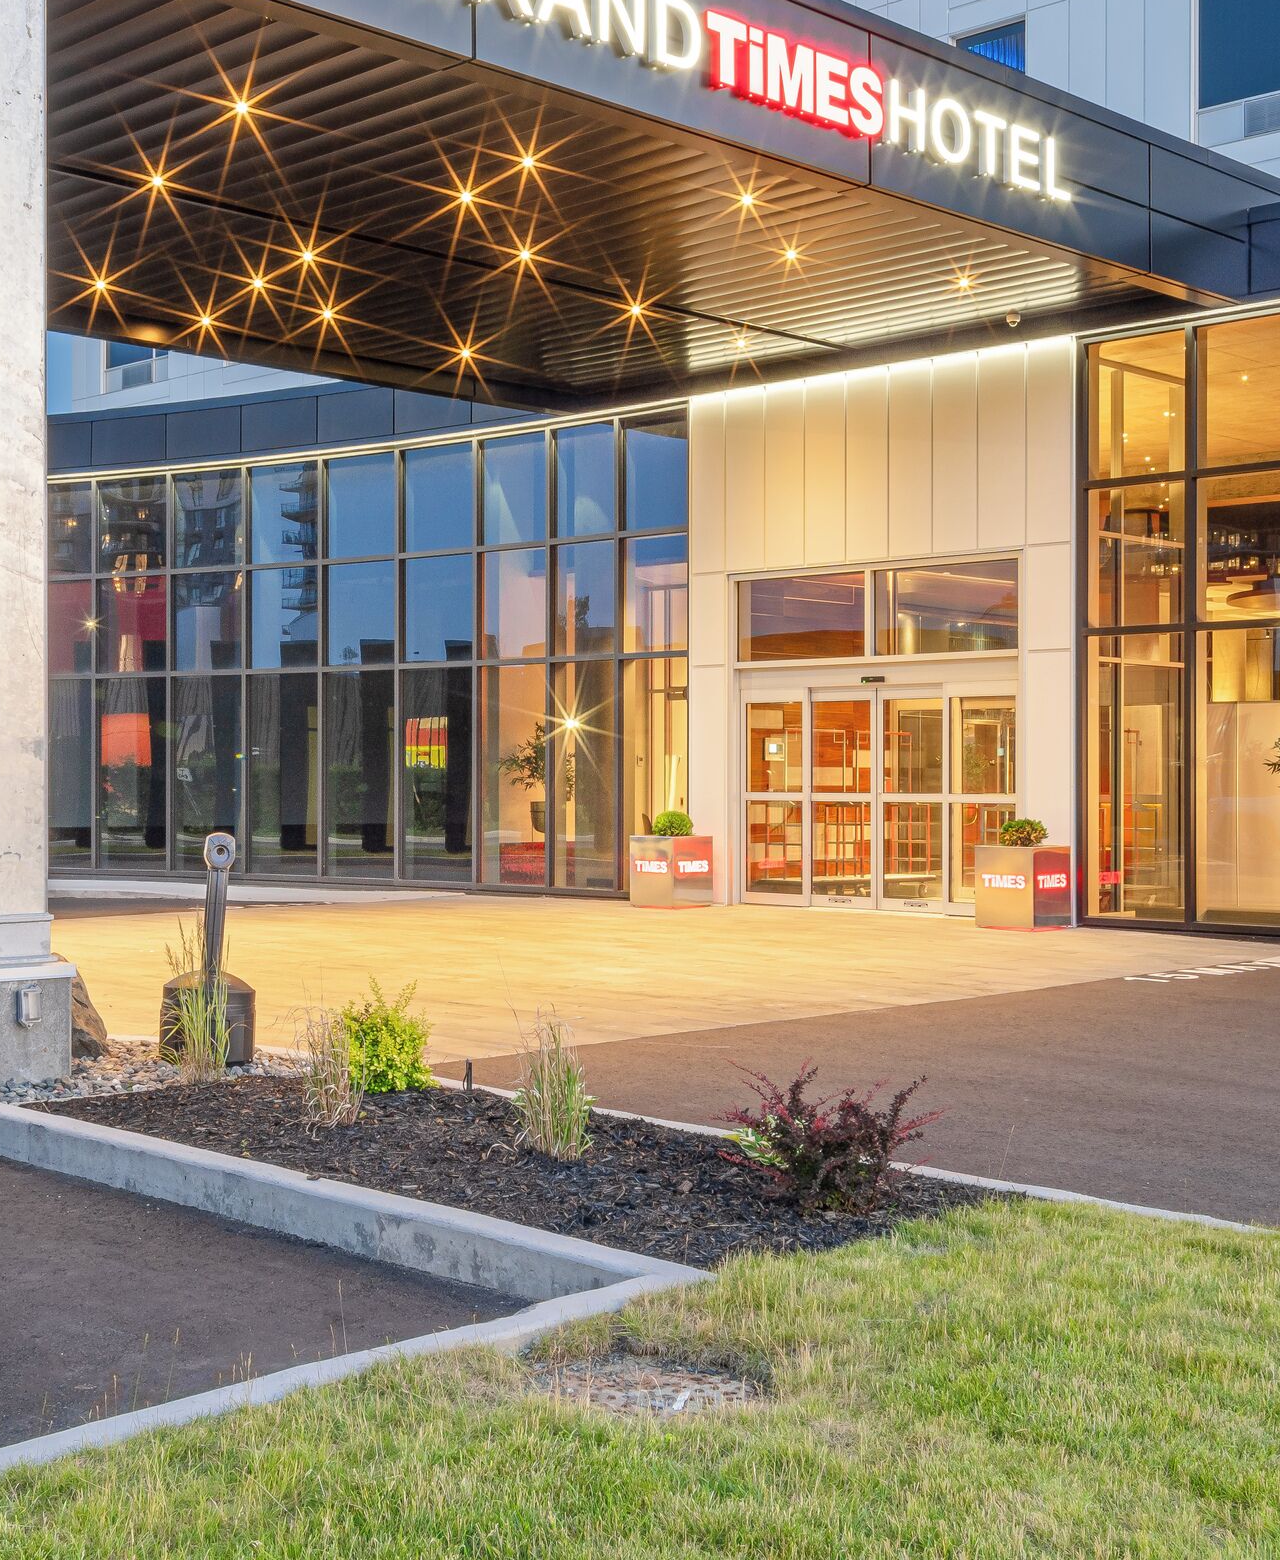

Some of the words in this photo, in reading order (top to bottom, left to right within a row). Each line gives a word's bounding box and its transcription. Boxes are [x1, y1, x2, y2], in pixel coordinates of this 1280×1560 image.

[706, 9, 886, 137] TiMES
[887, 79, 1072, 201] HOTEL
[982, 873, 1025, 889] TiMES
[1037, 874, 1067, 889] TiMES
